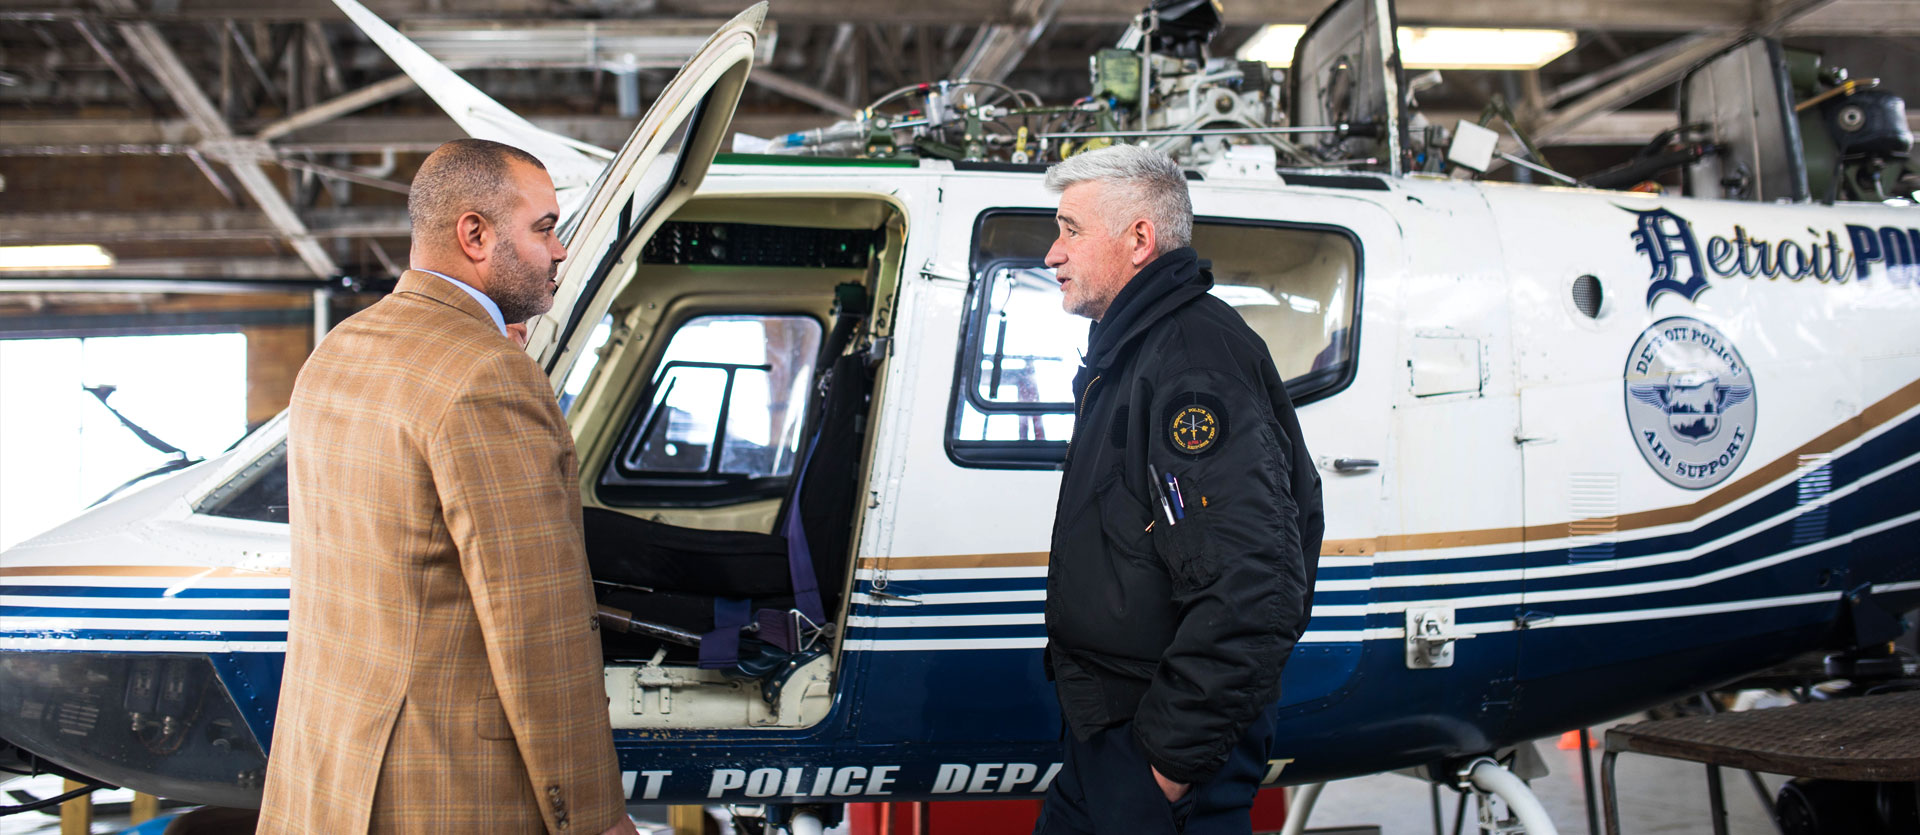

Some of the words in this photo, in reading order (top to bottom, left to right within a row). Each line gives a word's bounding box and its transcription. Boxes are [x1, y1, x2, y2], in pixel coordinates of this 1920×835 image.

[1610, 203, 1853, 310] Detroit
[1691, 328, 1742, 377] POLICE
[1643, 430, 1672, 466] AIR
[1675, 425, 1745, 478] SUPPORT
[706, 765, 901, 799] POLICE
